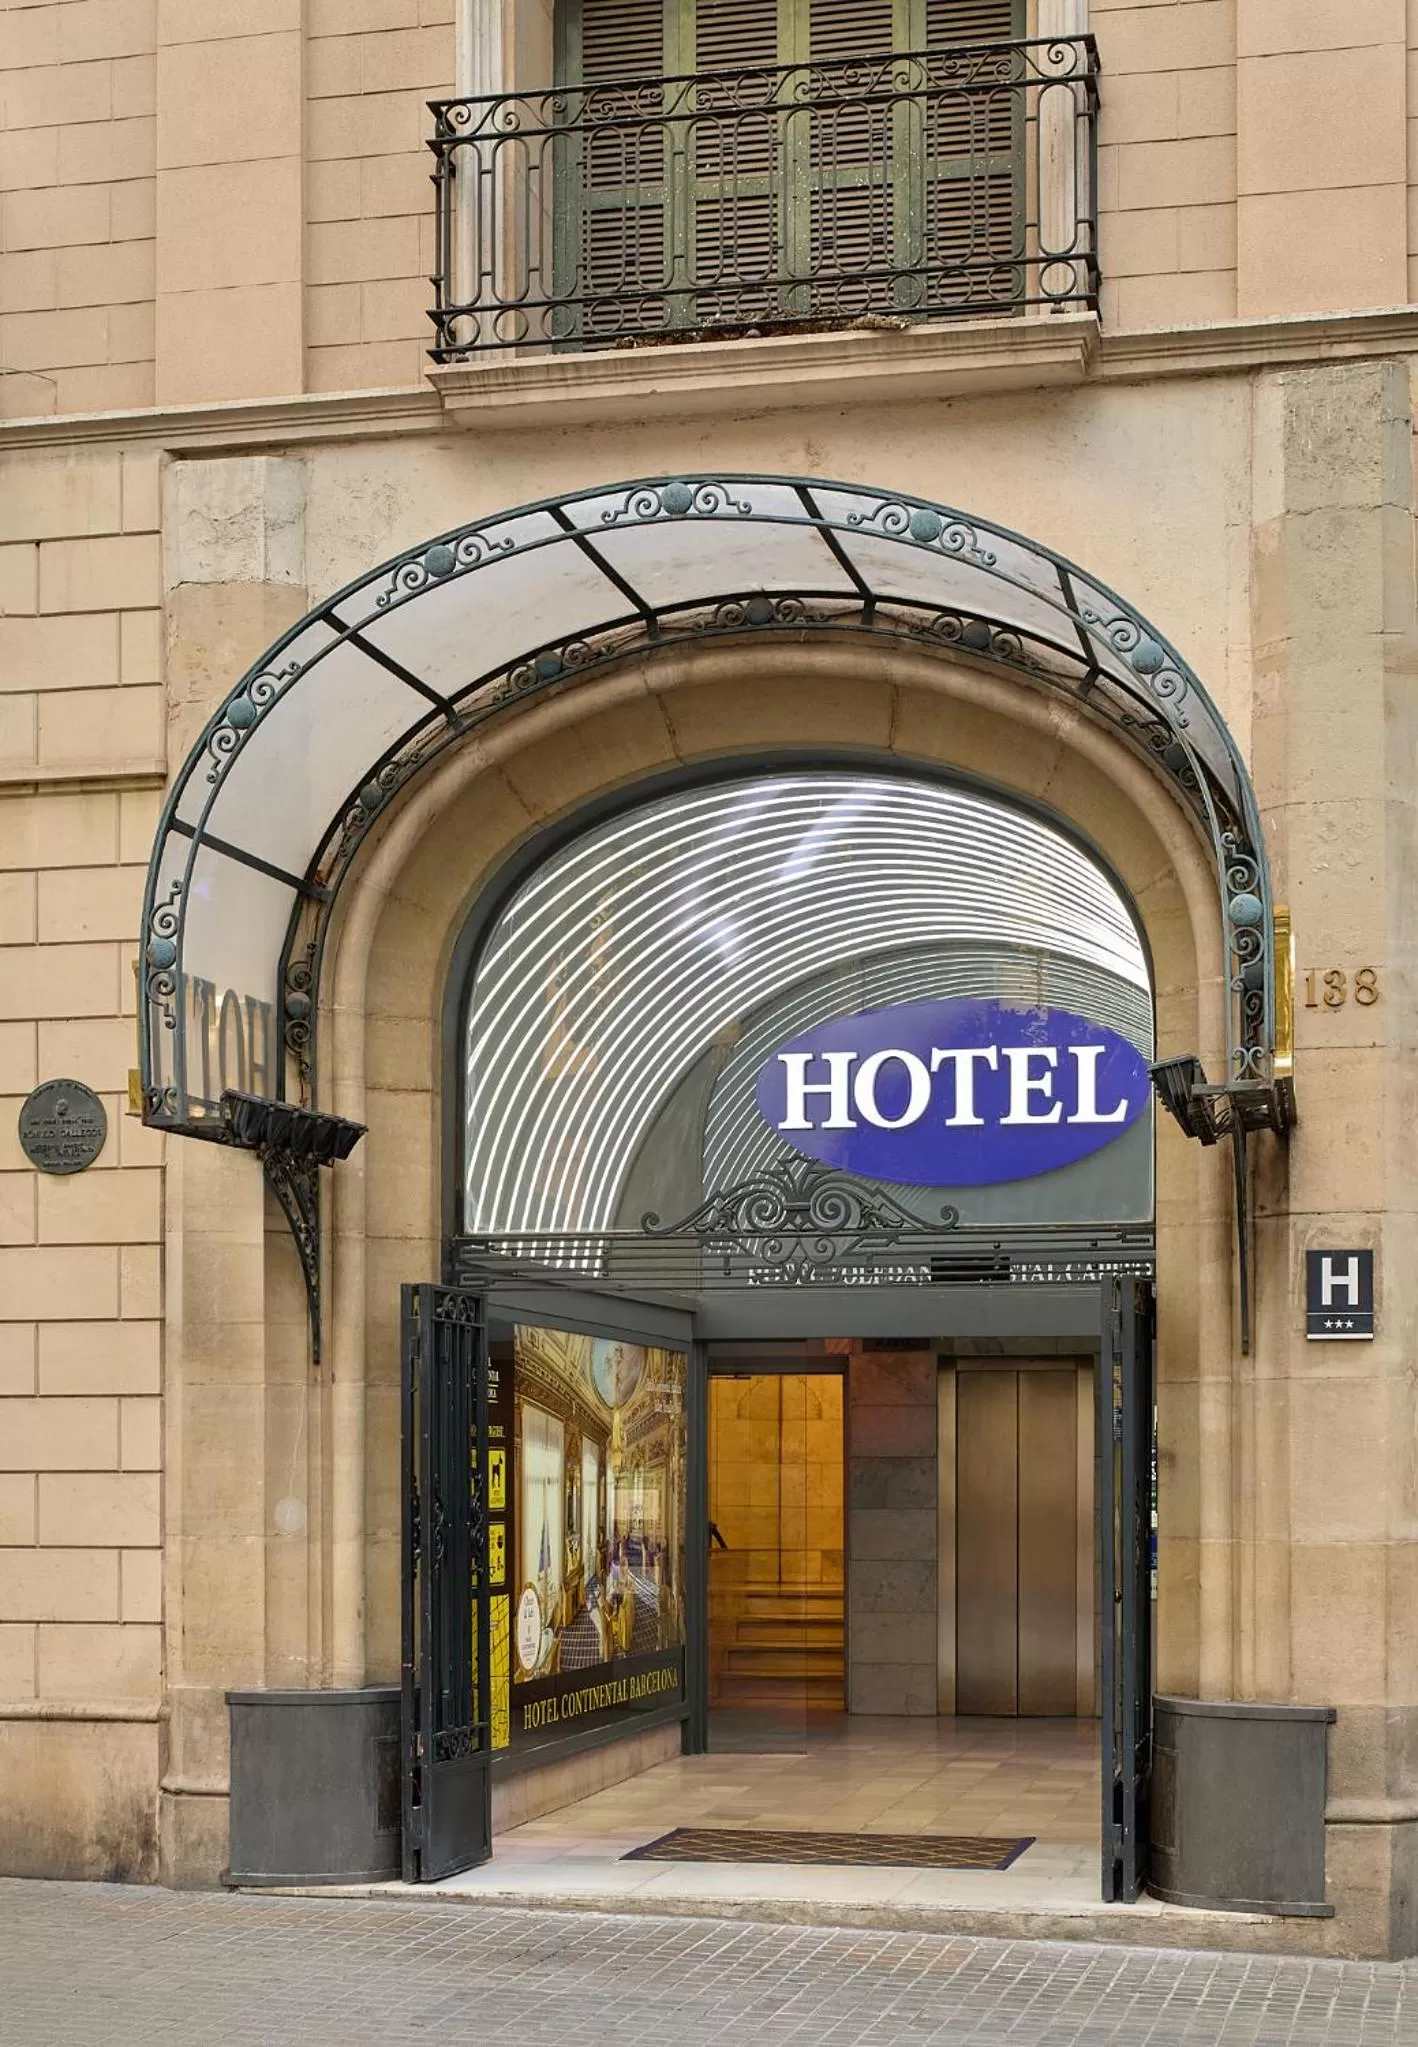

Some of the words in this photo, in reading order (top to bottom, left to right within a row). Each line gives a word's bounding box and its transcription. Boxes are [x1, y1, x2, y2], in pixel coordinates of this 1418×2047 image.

[1304, 967, 1379, 1008] 138
[777, 1044, 1129, 1131] HOTEL
[1320, 1256, 1360, 1306] H
[523, 1696, 559, 1731] HOTEL
[561, 1678, 629, 1720] CONTINENTAL
[629, 1666, 678, 1699] BARCELONA
